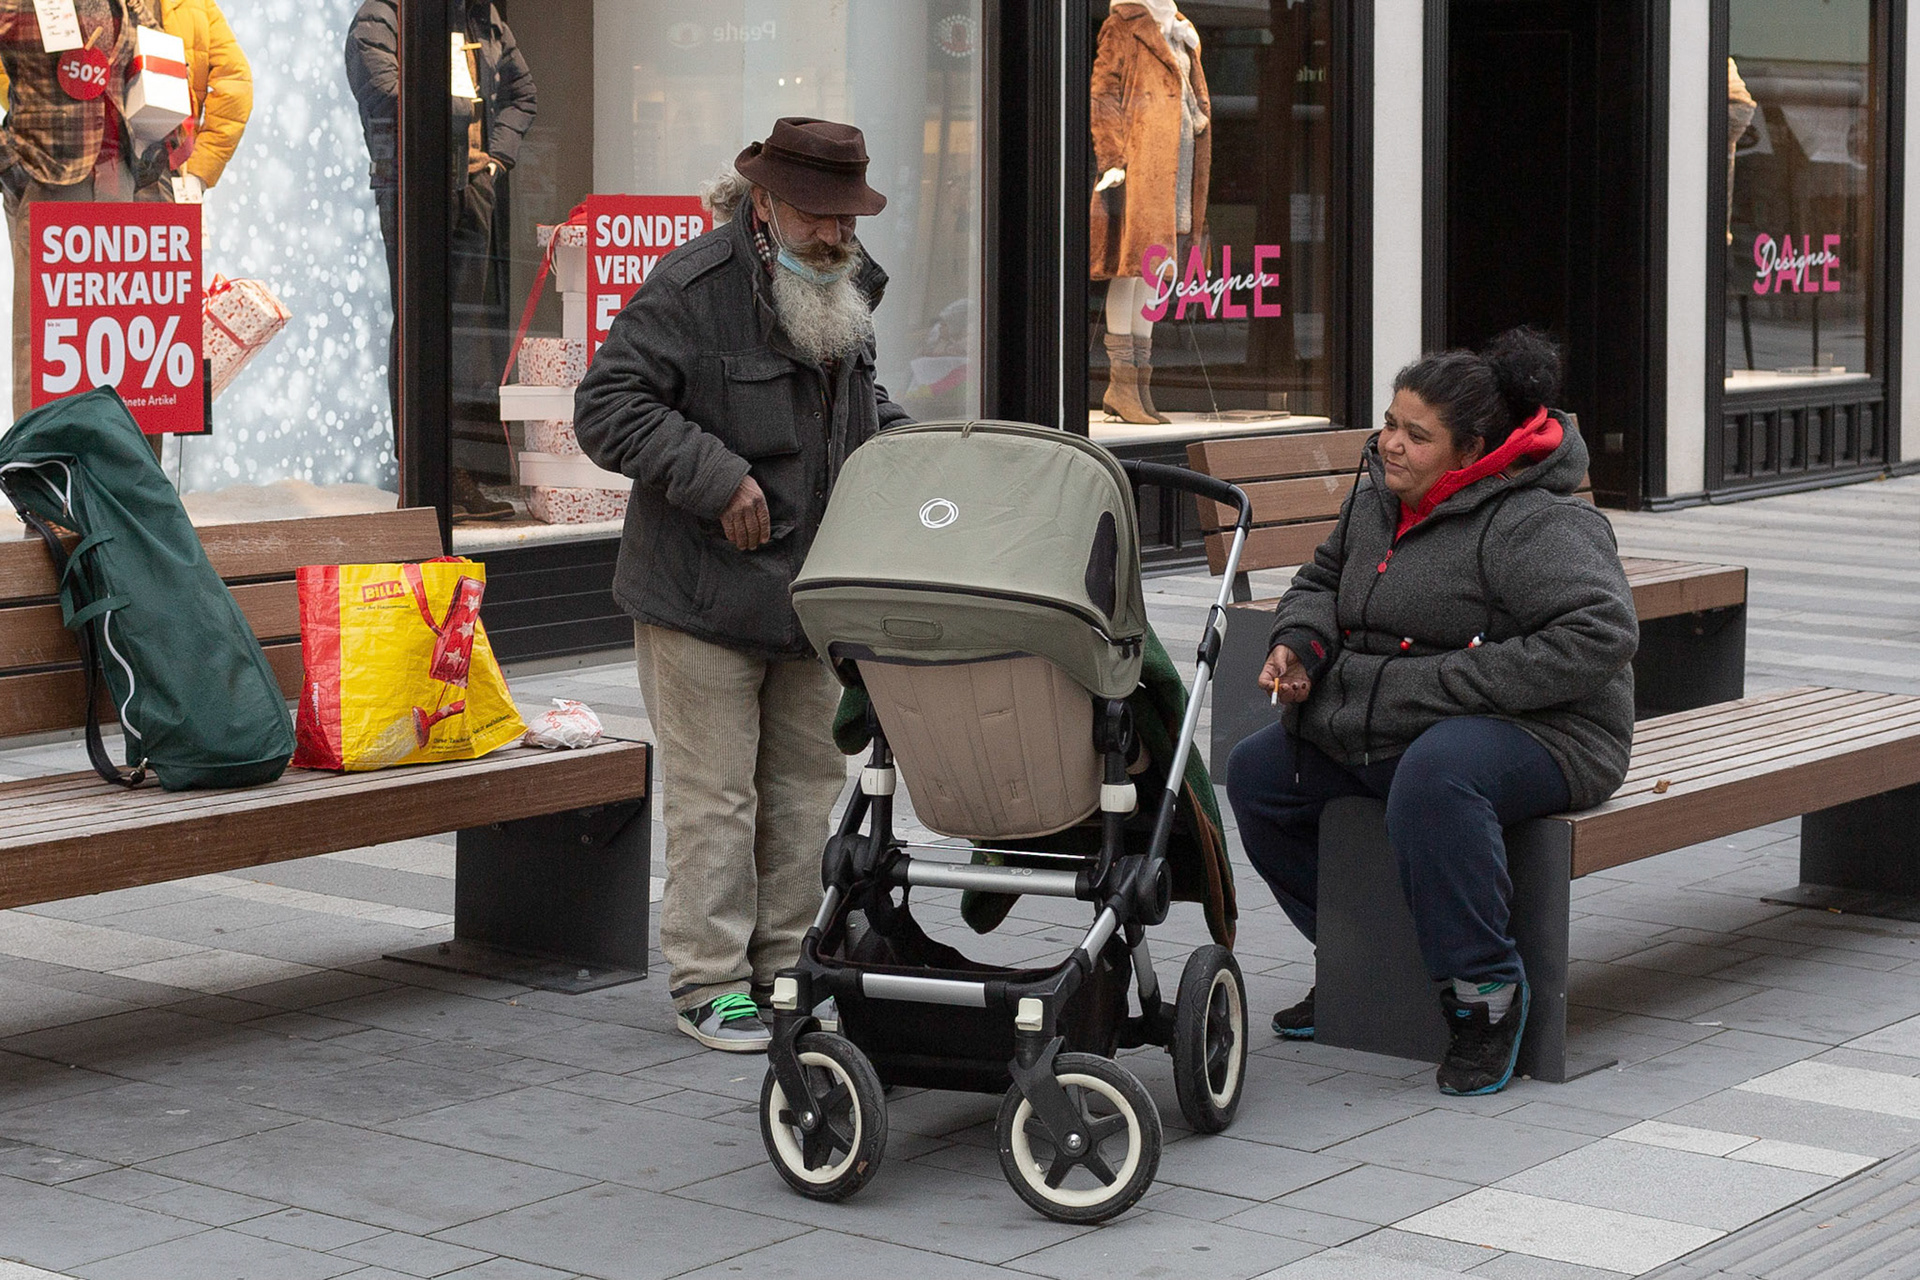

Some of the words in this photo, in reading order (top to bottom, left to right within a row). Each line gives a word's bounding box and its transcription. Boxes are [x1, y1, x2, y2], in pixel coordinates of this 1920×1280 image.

[62, 61, 106, 86] -50%
[42, 225, 193, 264] SONDER
[595, 215, 704, 247] SONDER
[594, 255, 659, 285] VERK
[1753, 232, 1841, 295] SALE
[1756, 238, 1836, 286] Designer
[41, 271, 192, 307] VERKAUF
[1141, 245, 1282, 322] SALE
[1146, 257, 1274, 316] Designer
[42, 315, 195, 394] 50%
[121, 395, 146, 407] hnete
[148, 393, 177, 406] Artikel
[364, 582, 403, 600] BILLA
